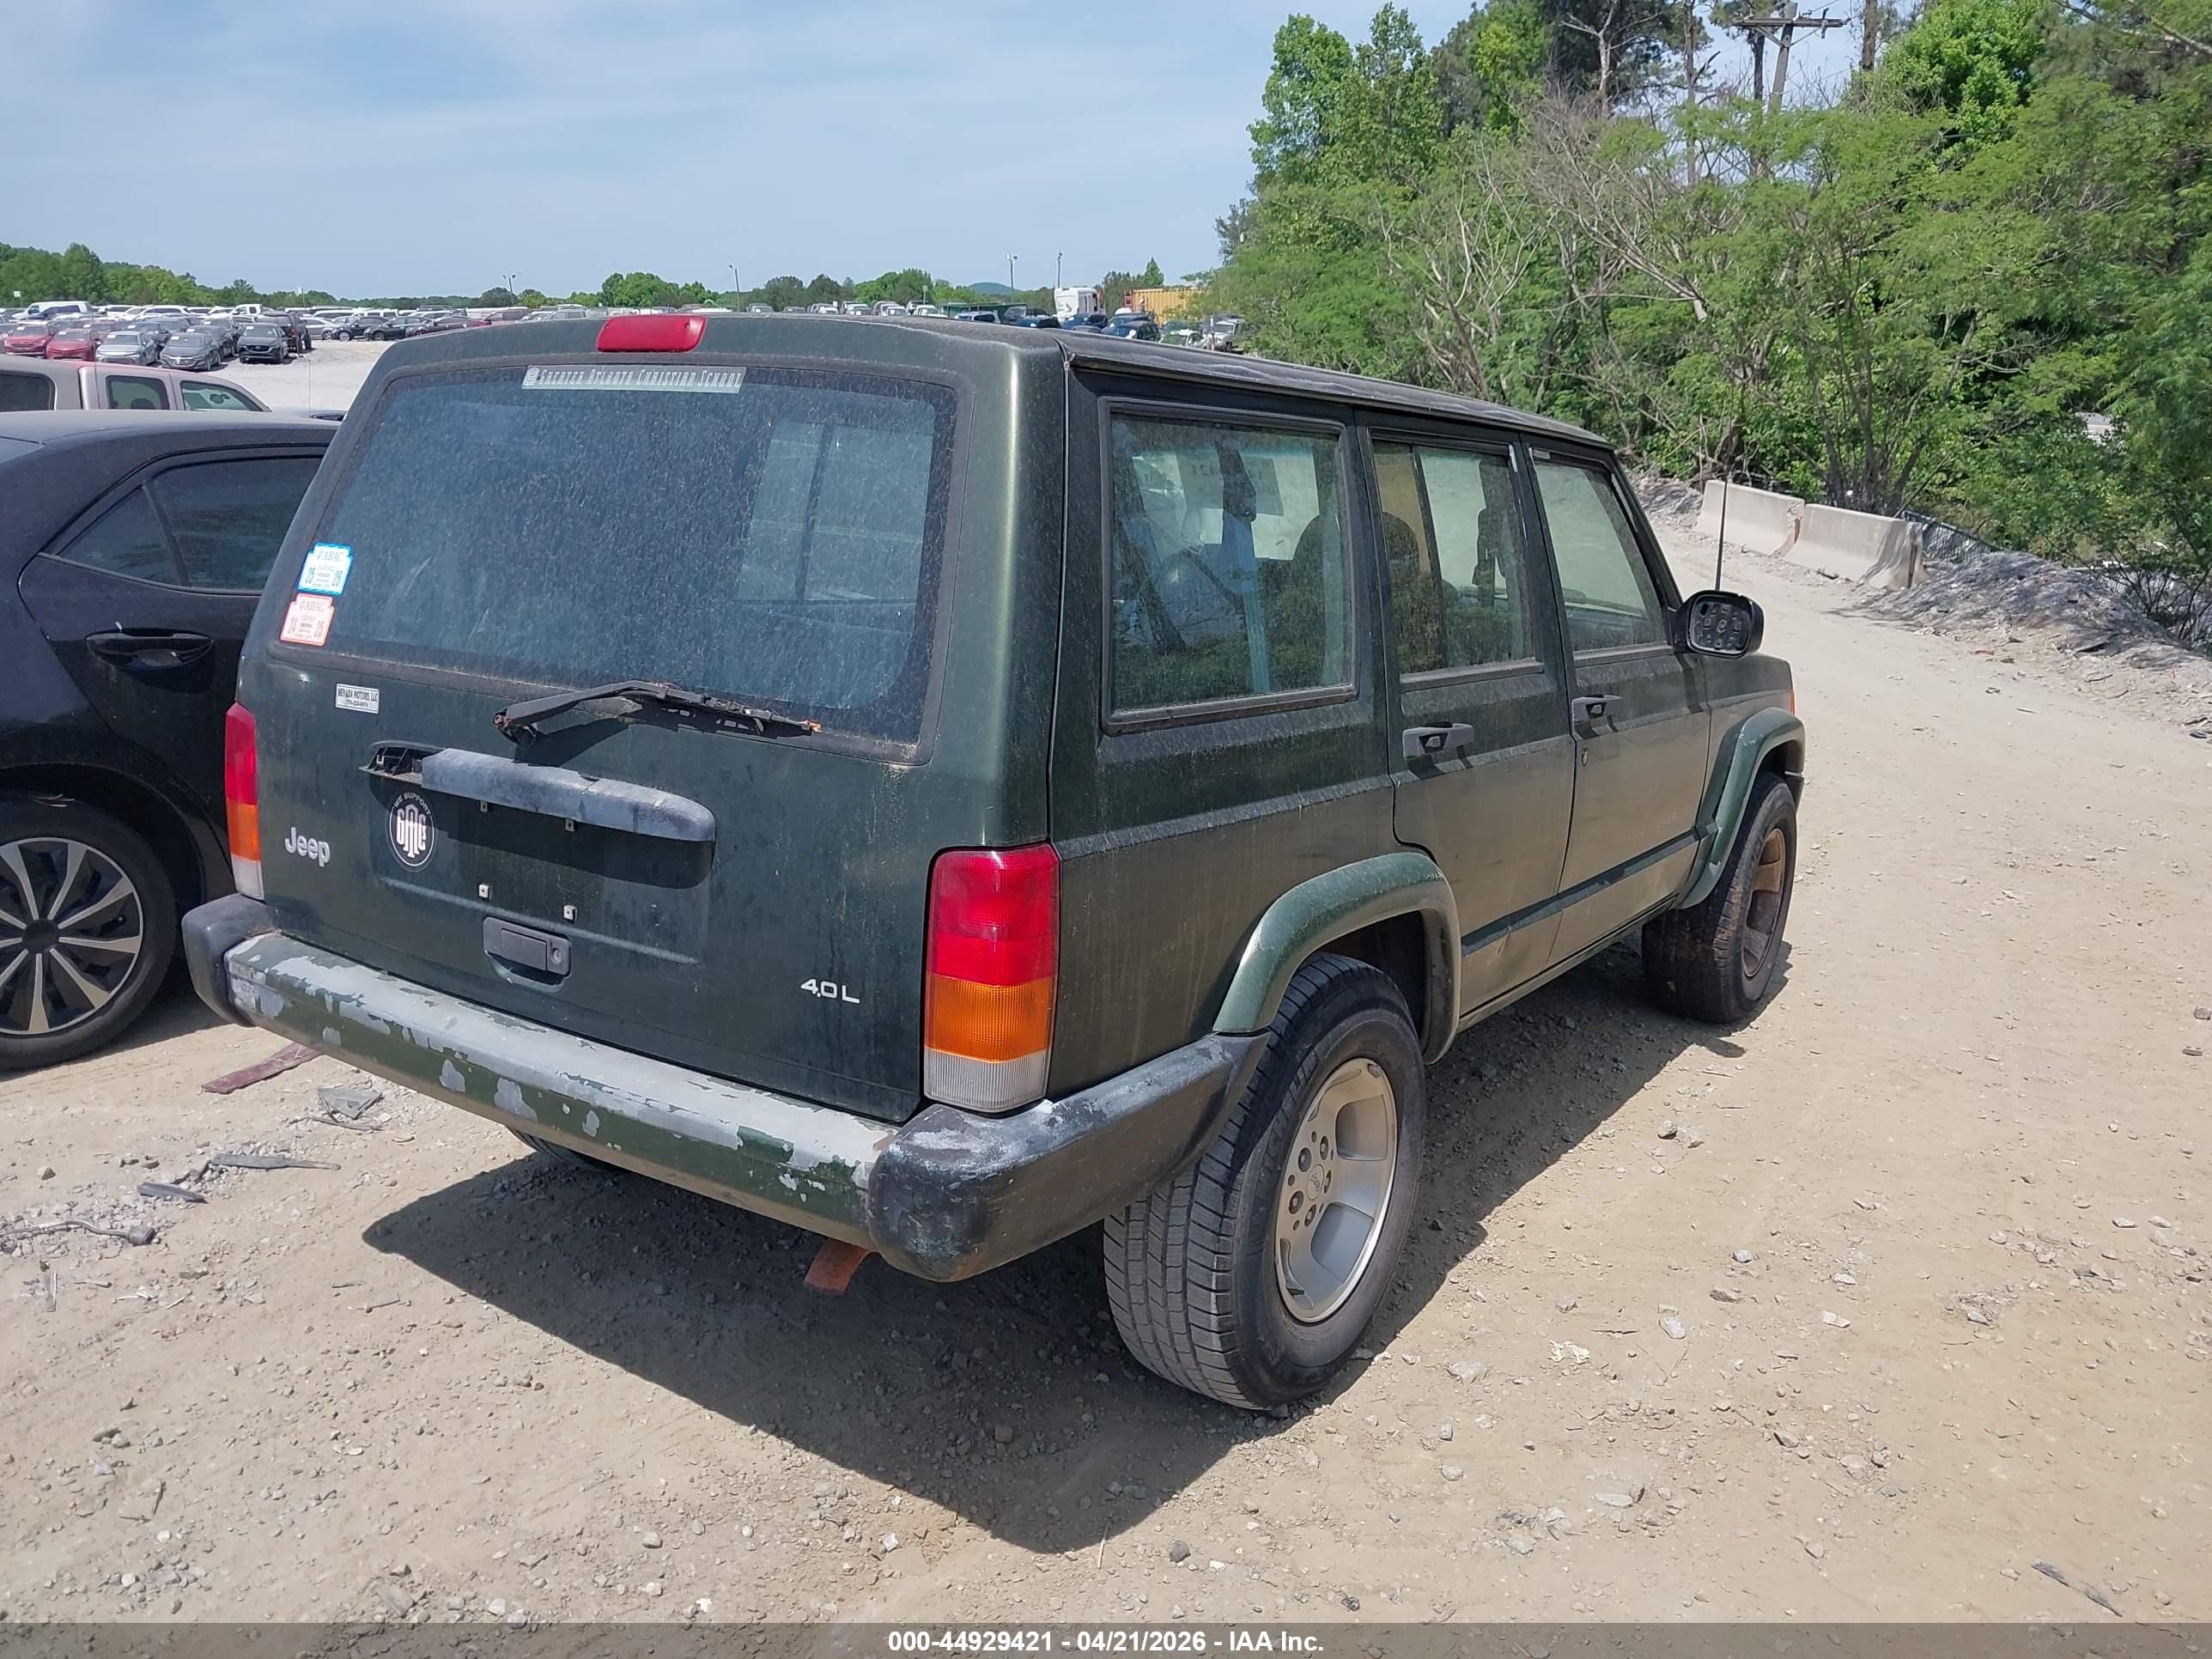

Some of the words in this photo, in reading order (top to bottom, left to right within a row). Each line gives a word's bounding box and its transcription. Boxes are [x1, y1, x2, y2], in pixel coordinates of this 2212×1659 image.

[337, 688, 353, 699] NEVADA
[393, 795, 404, 808] WE
[404, 792, 431, 815] SUPPORT
[284, 827, 331, 867] Jeep
